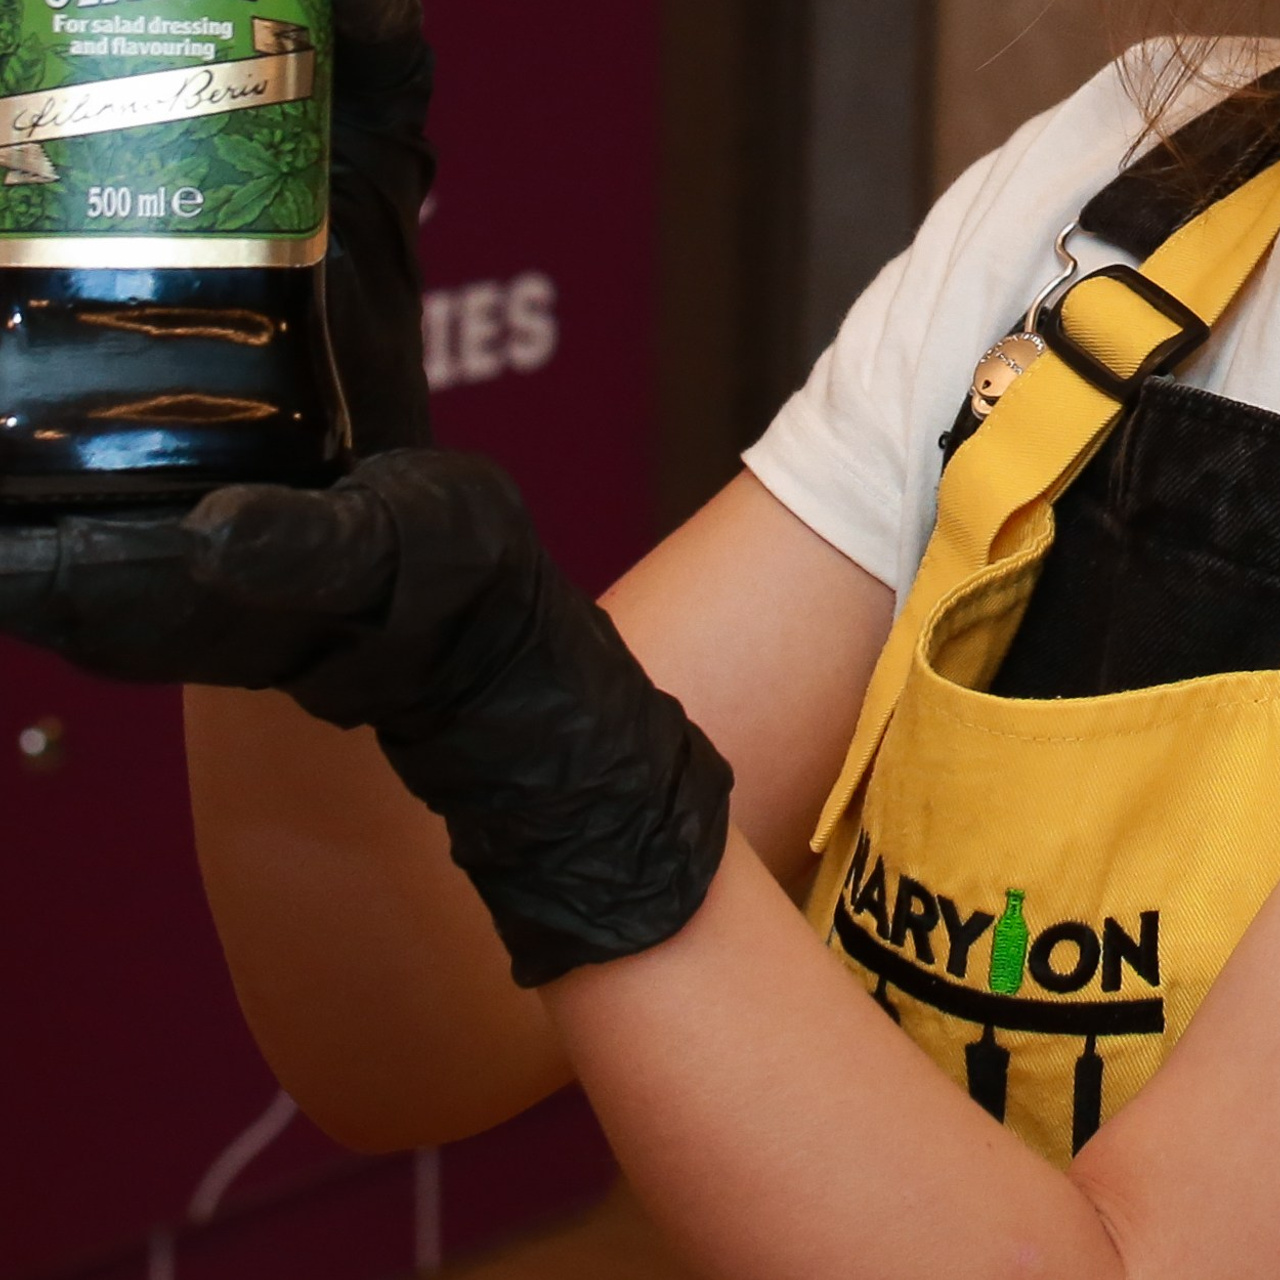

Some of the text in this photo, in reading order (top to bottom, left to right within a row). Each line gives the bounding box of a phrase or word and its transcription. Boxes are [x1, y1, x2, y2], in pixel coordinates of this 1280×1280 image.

[52, 14, 235, 40] For salad dressing
[69, 37, 217, 61] and flavouring
[87, 187, 132, 218] 500
[137, 186, 166, 218] ml
[1027, 908, 1161, 994] ON
